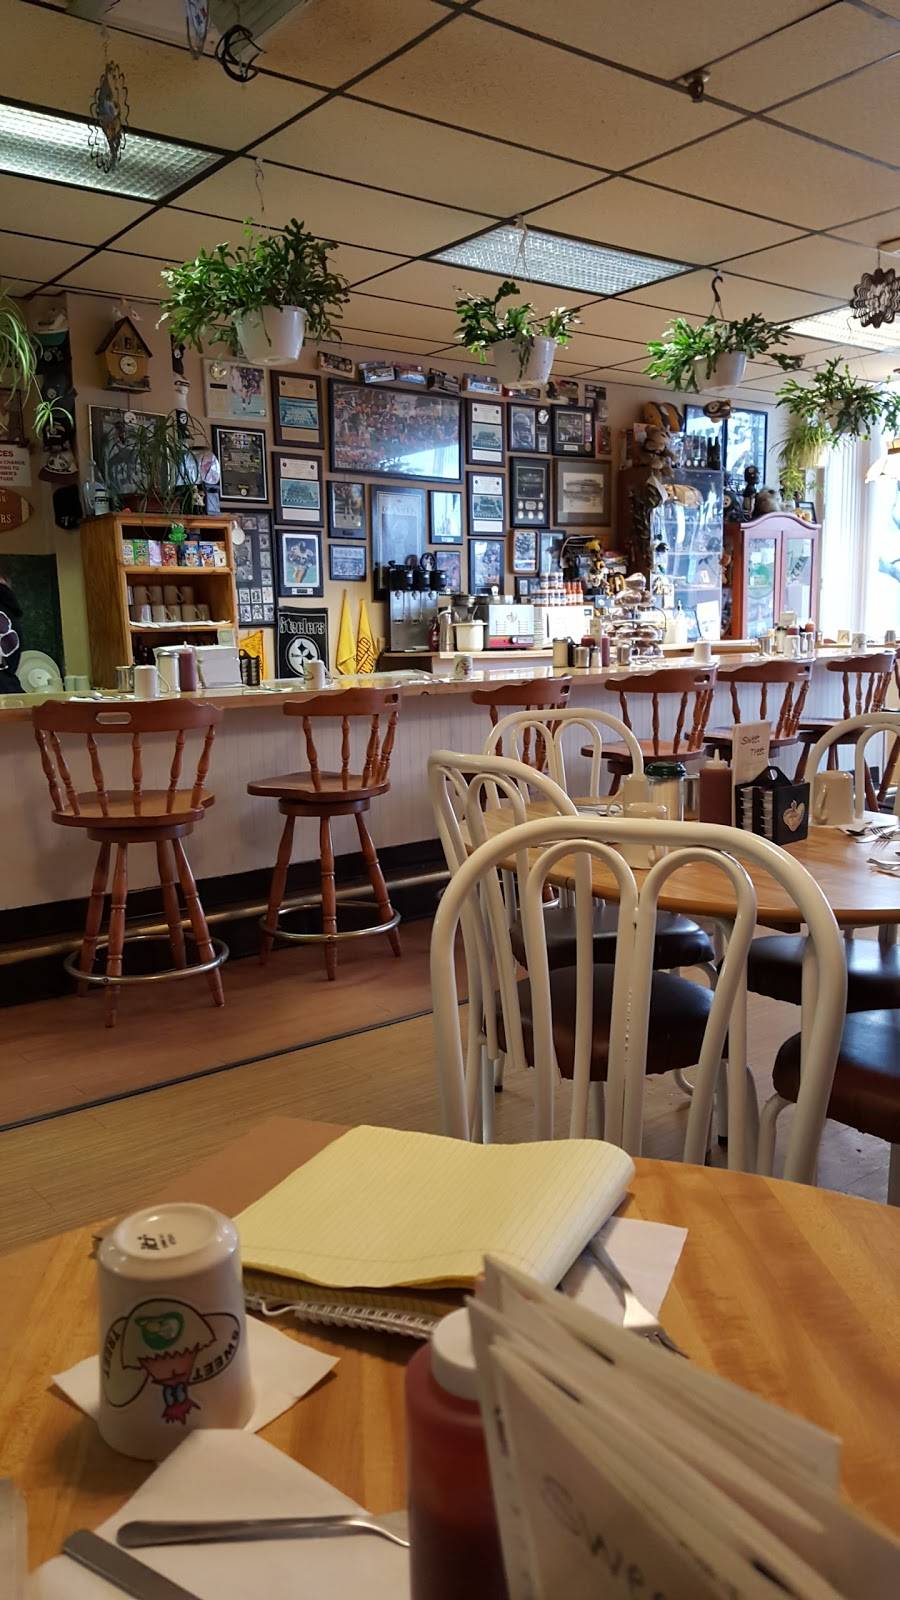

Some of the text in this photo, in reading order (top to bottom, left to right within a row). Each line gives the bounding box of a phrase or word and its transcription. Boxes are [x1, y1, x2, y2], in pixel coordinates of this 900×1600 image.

[279, 616, 325, 635] Steelers
[103, 1327, 121, 1379] TREET
[193, 1329, 240, 1381] SWEET
